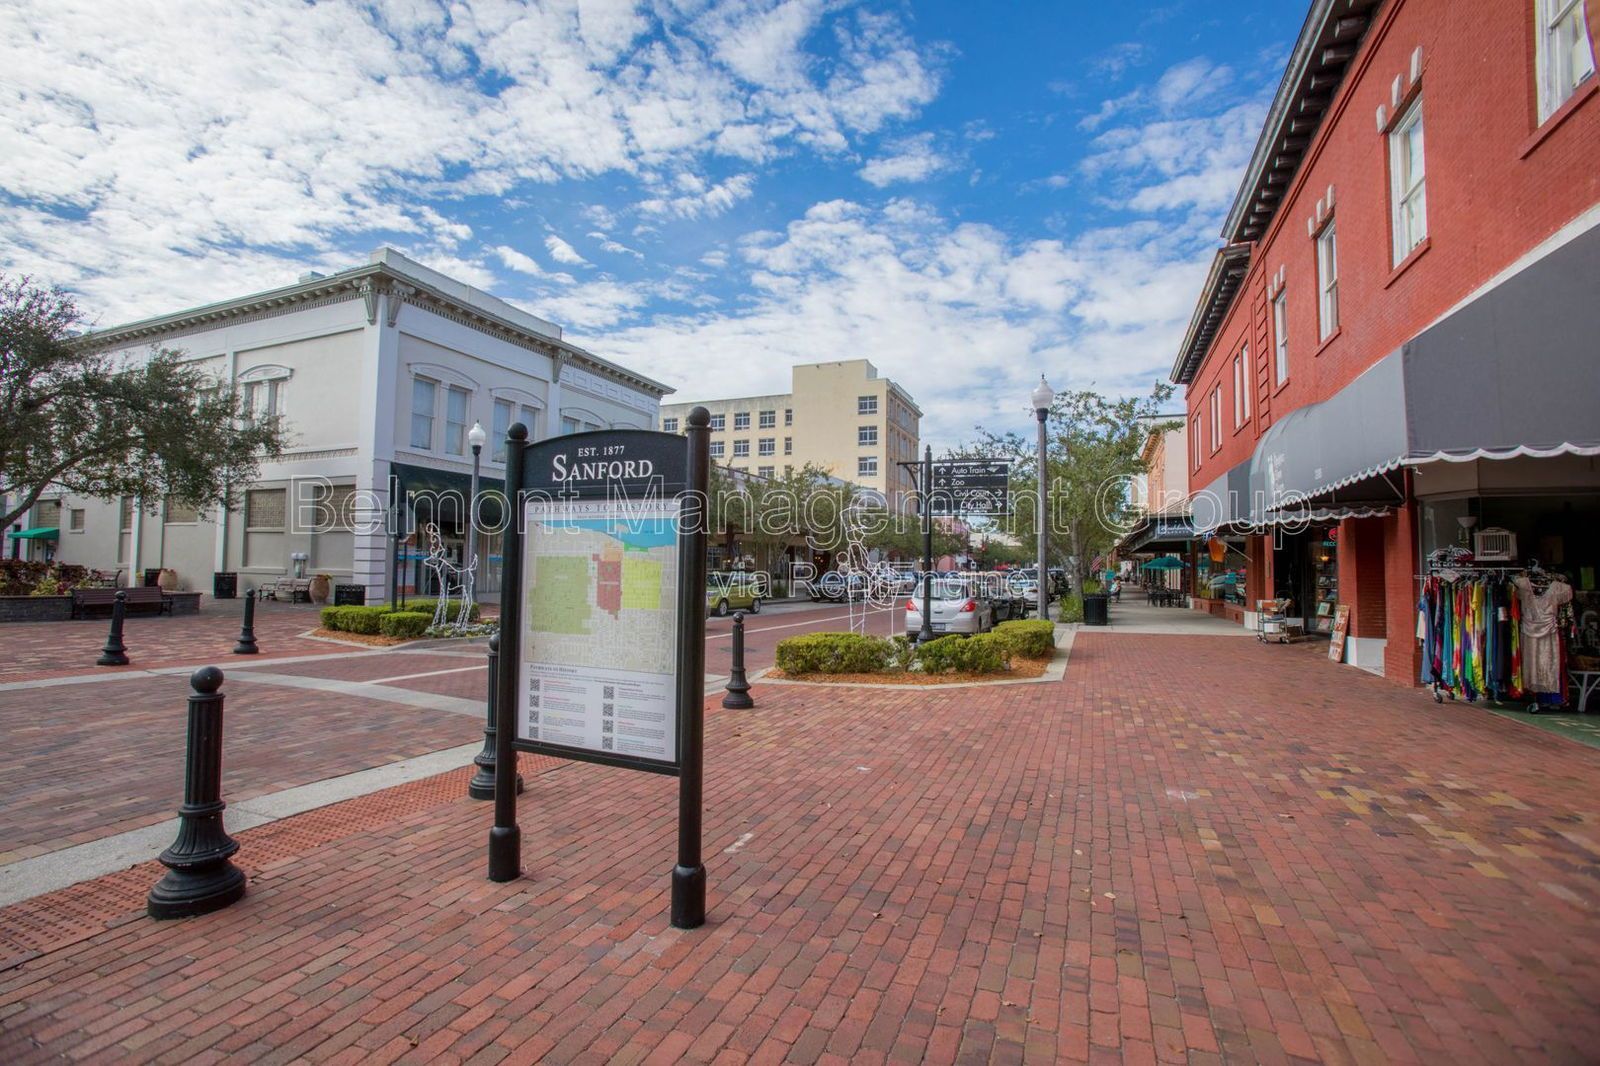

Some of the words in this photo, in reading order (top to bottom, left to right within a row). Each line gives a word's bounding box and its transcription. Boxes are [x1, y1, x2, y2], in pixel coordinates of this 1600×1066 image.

[578, 447, 600, 457] EST.
[603, 445, 625, 456] 1877
[552, 453, 653, 482] SANFORD
[968, 466, 986, 474] Train
[953, 489, 969, 497] Civil
[617, 503, 668, 512] HISTORY
